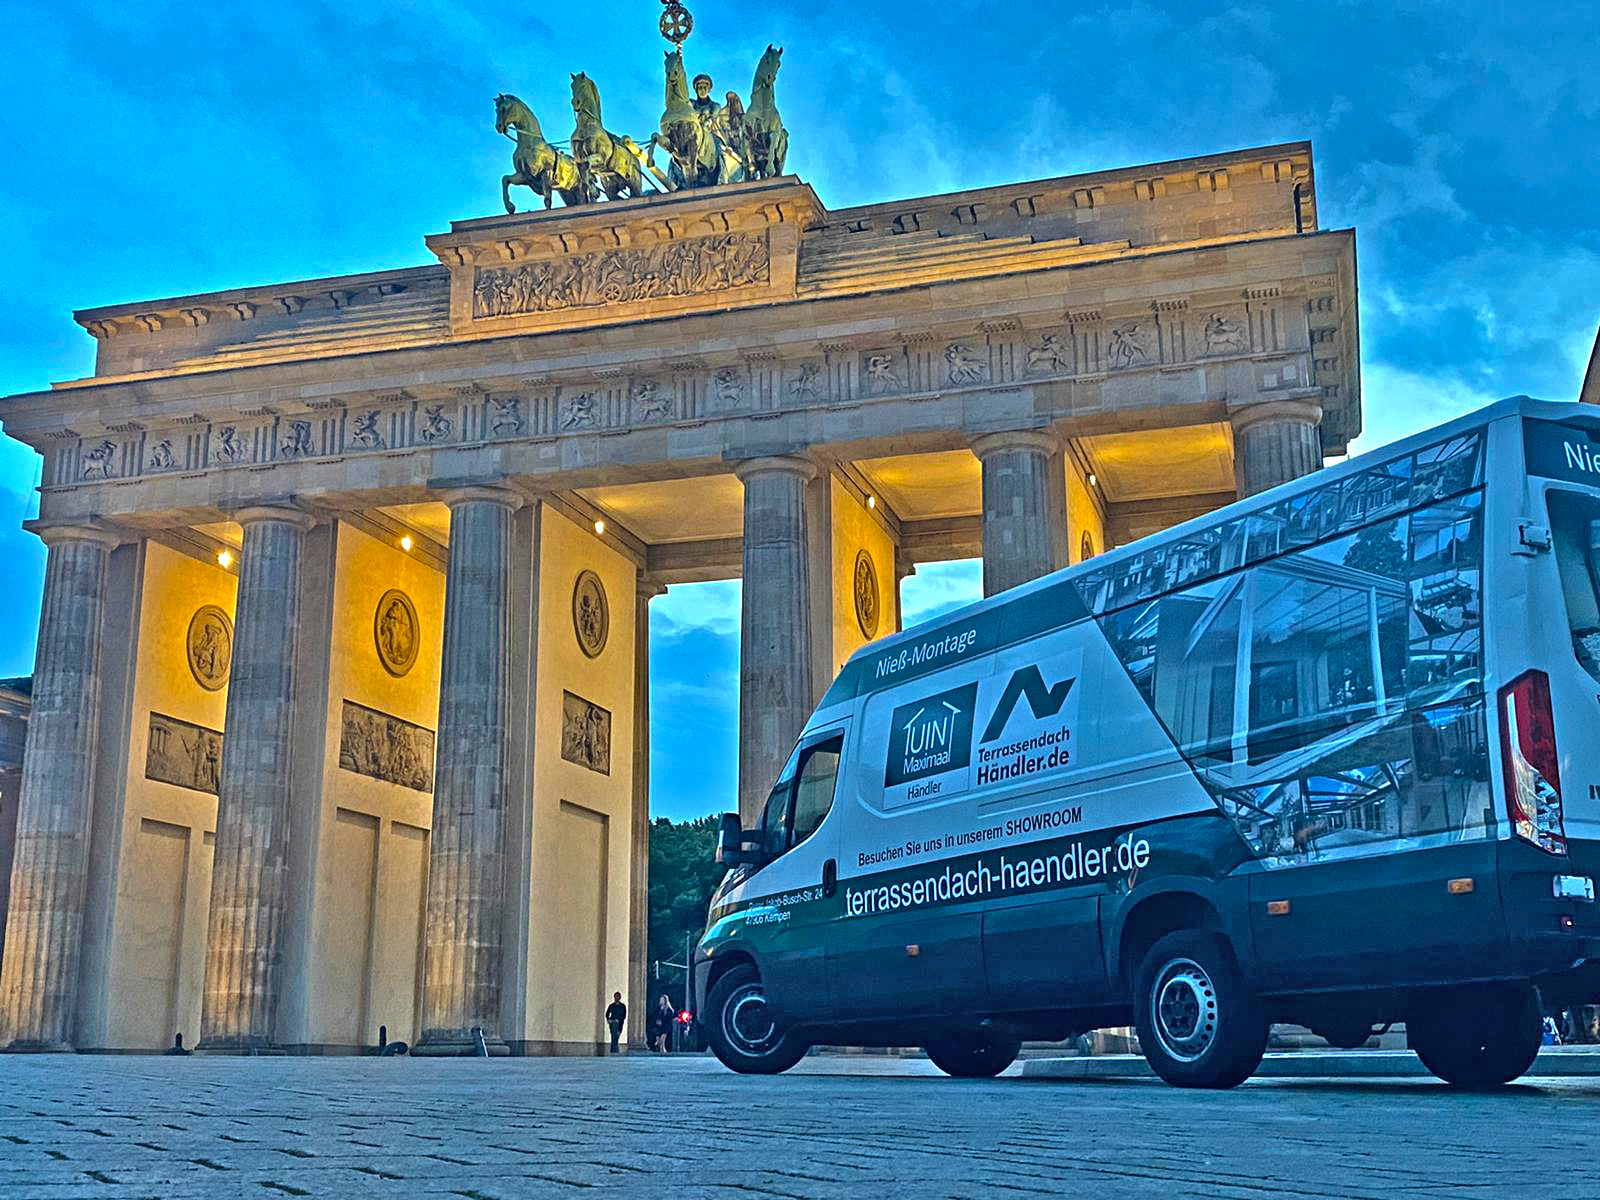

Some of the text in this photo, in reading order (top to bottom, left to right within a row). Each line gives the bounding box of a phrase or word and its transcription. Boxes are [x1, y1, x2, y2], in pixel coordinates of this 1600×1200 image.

[876, 628, 977, 680] Nieß-Montage
[904, 751, 951, 775] Maximaal
[978, 726, 1070, 763] Terrassendach
[977, 747, 1070, 785] Händler.de
[907, 782, 942, 800] Händler
[858, 806, 1082, 867] Besuchen Sie uns in unserem SHOWROOM
[846, 832, 1150, 917] terrassendach-haendler.de
